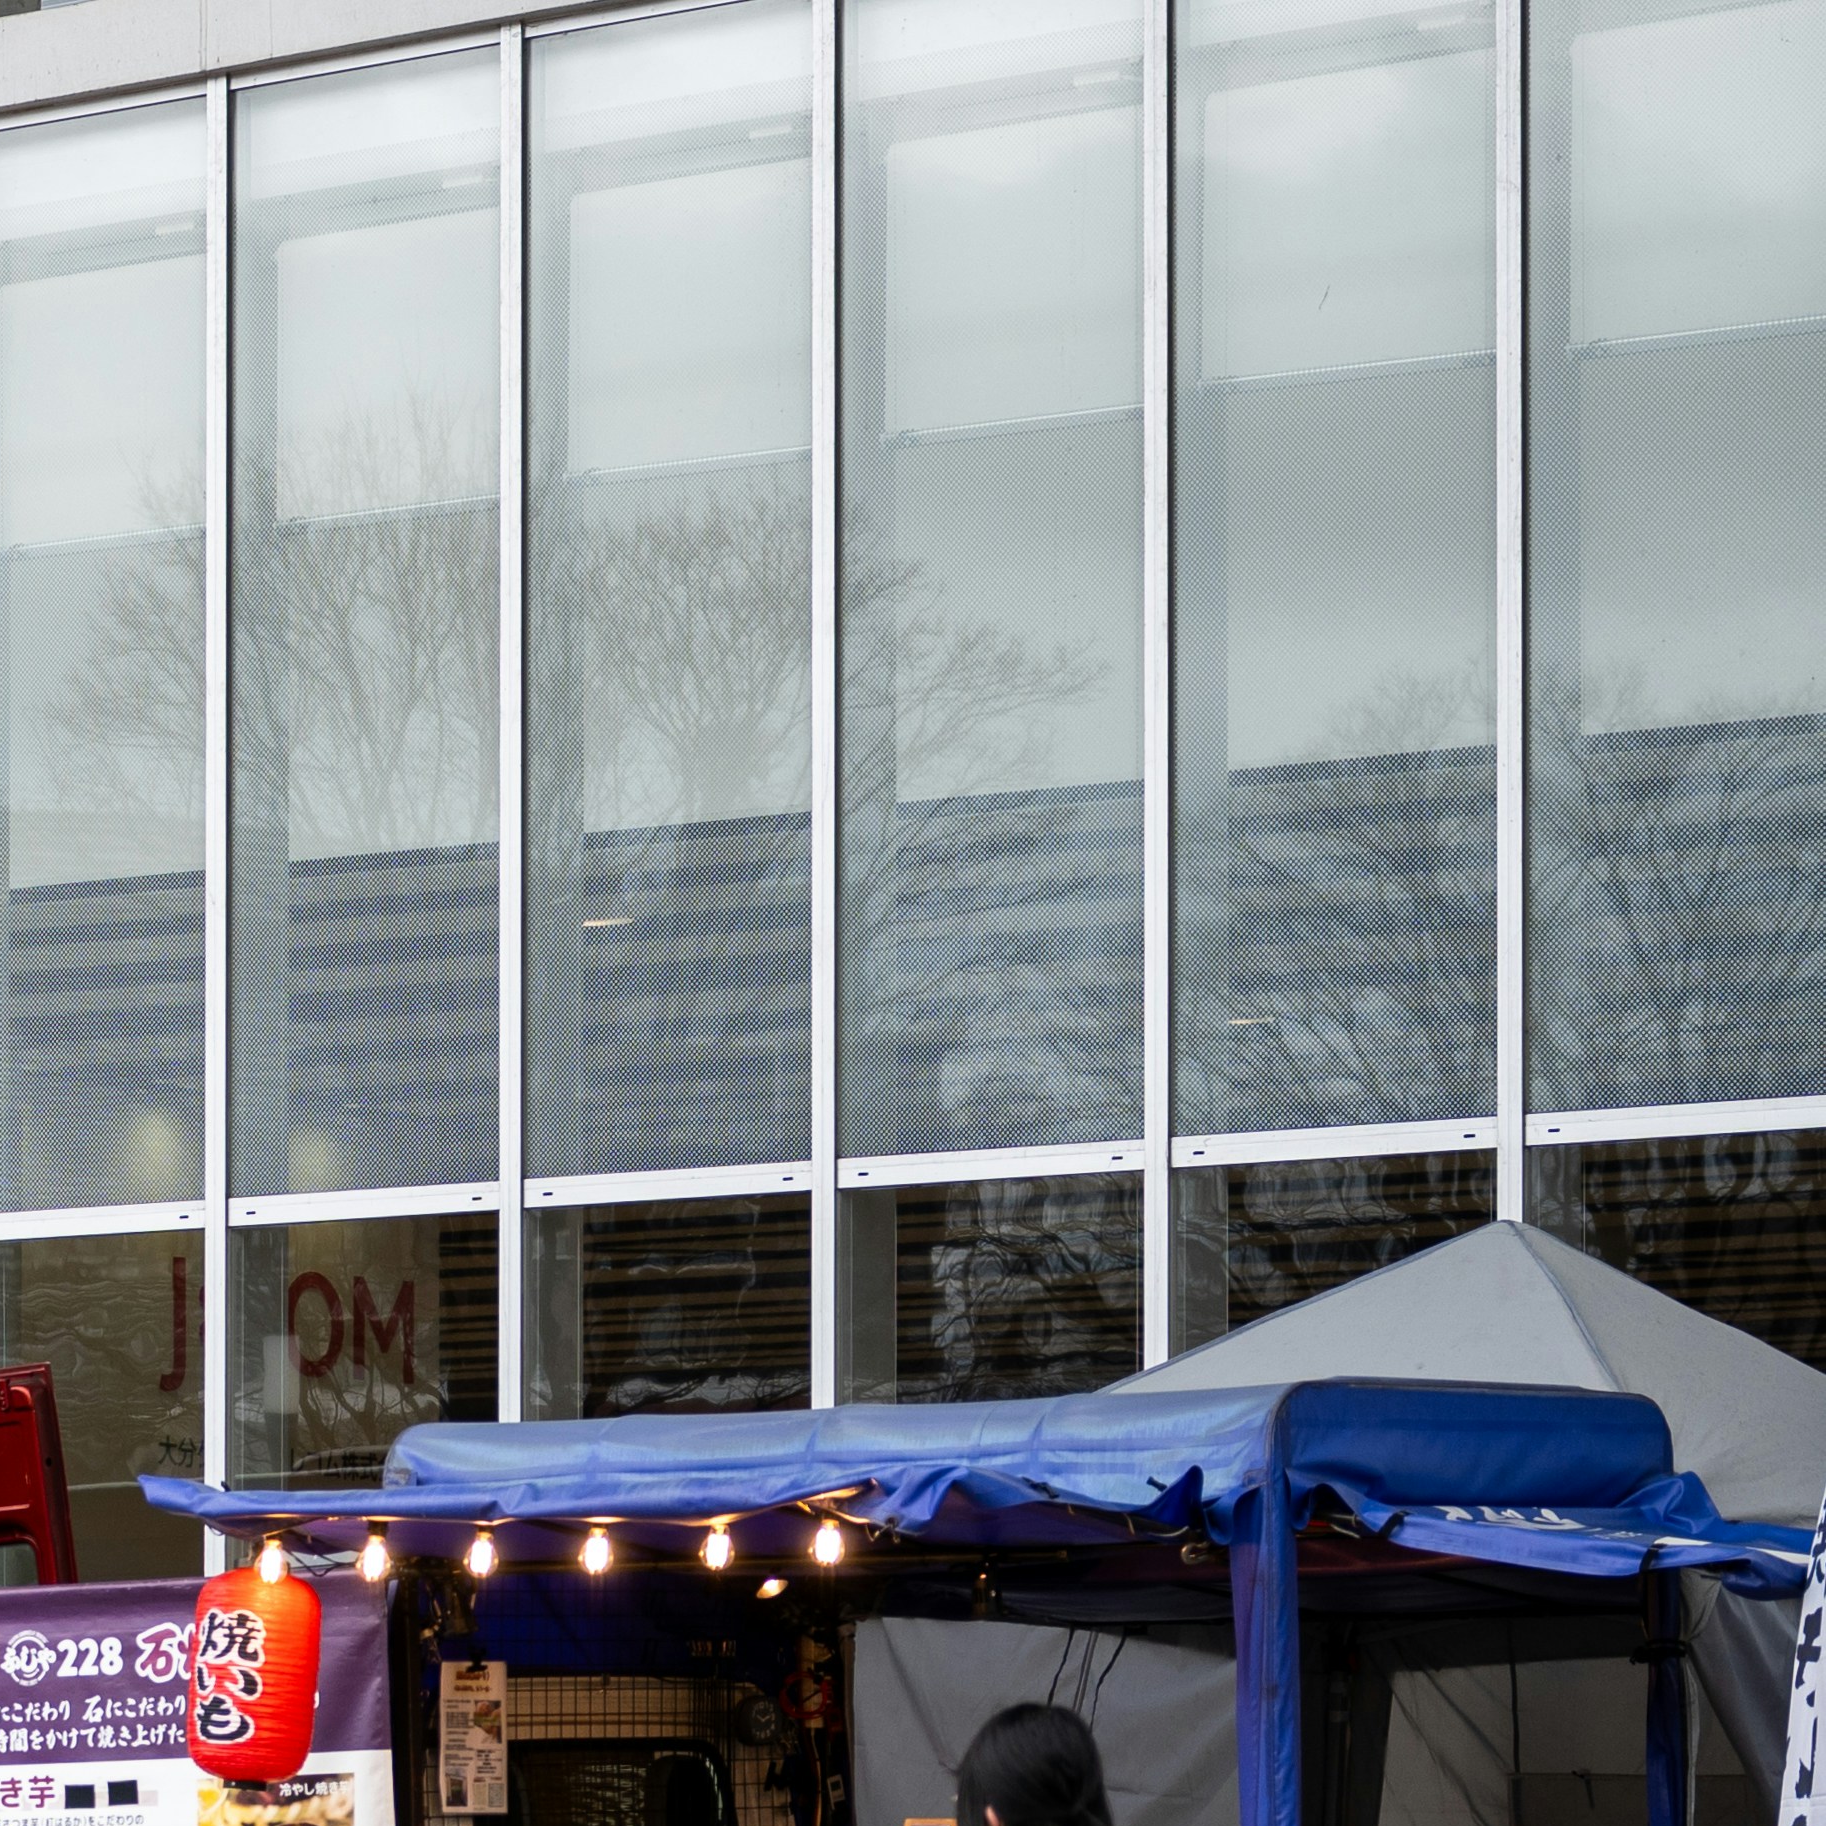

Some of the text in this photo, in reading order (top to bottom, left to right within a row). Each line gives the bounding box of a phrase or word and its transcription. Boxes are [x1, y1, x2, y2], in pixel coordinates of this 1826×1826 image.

[56, 1637, 123, 1677] 228
[195, 1608, 267, 1743] 焼いも
